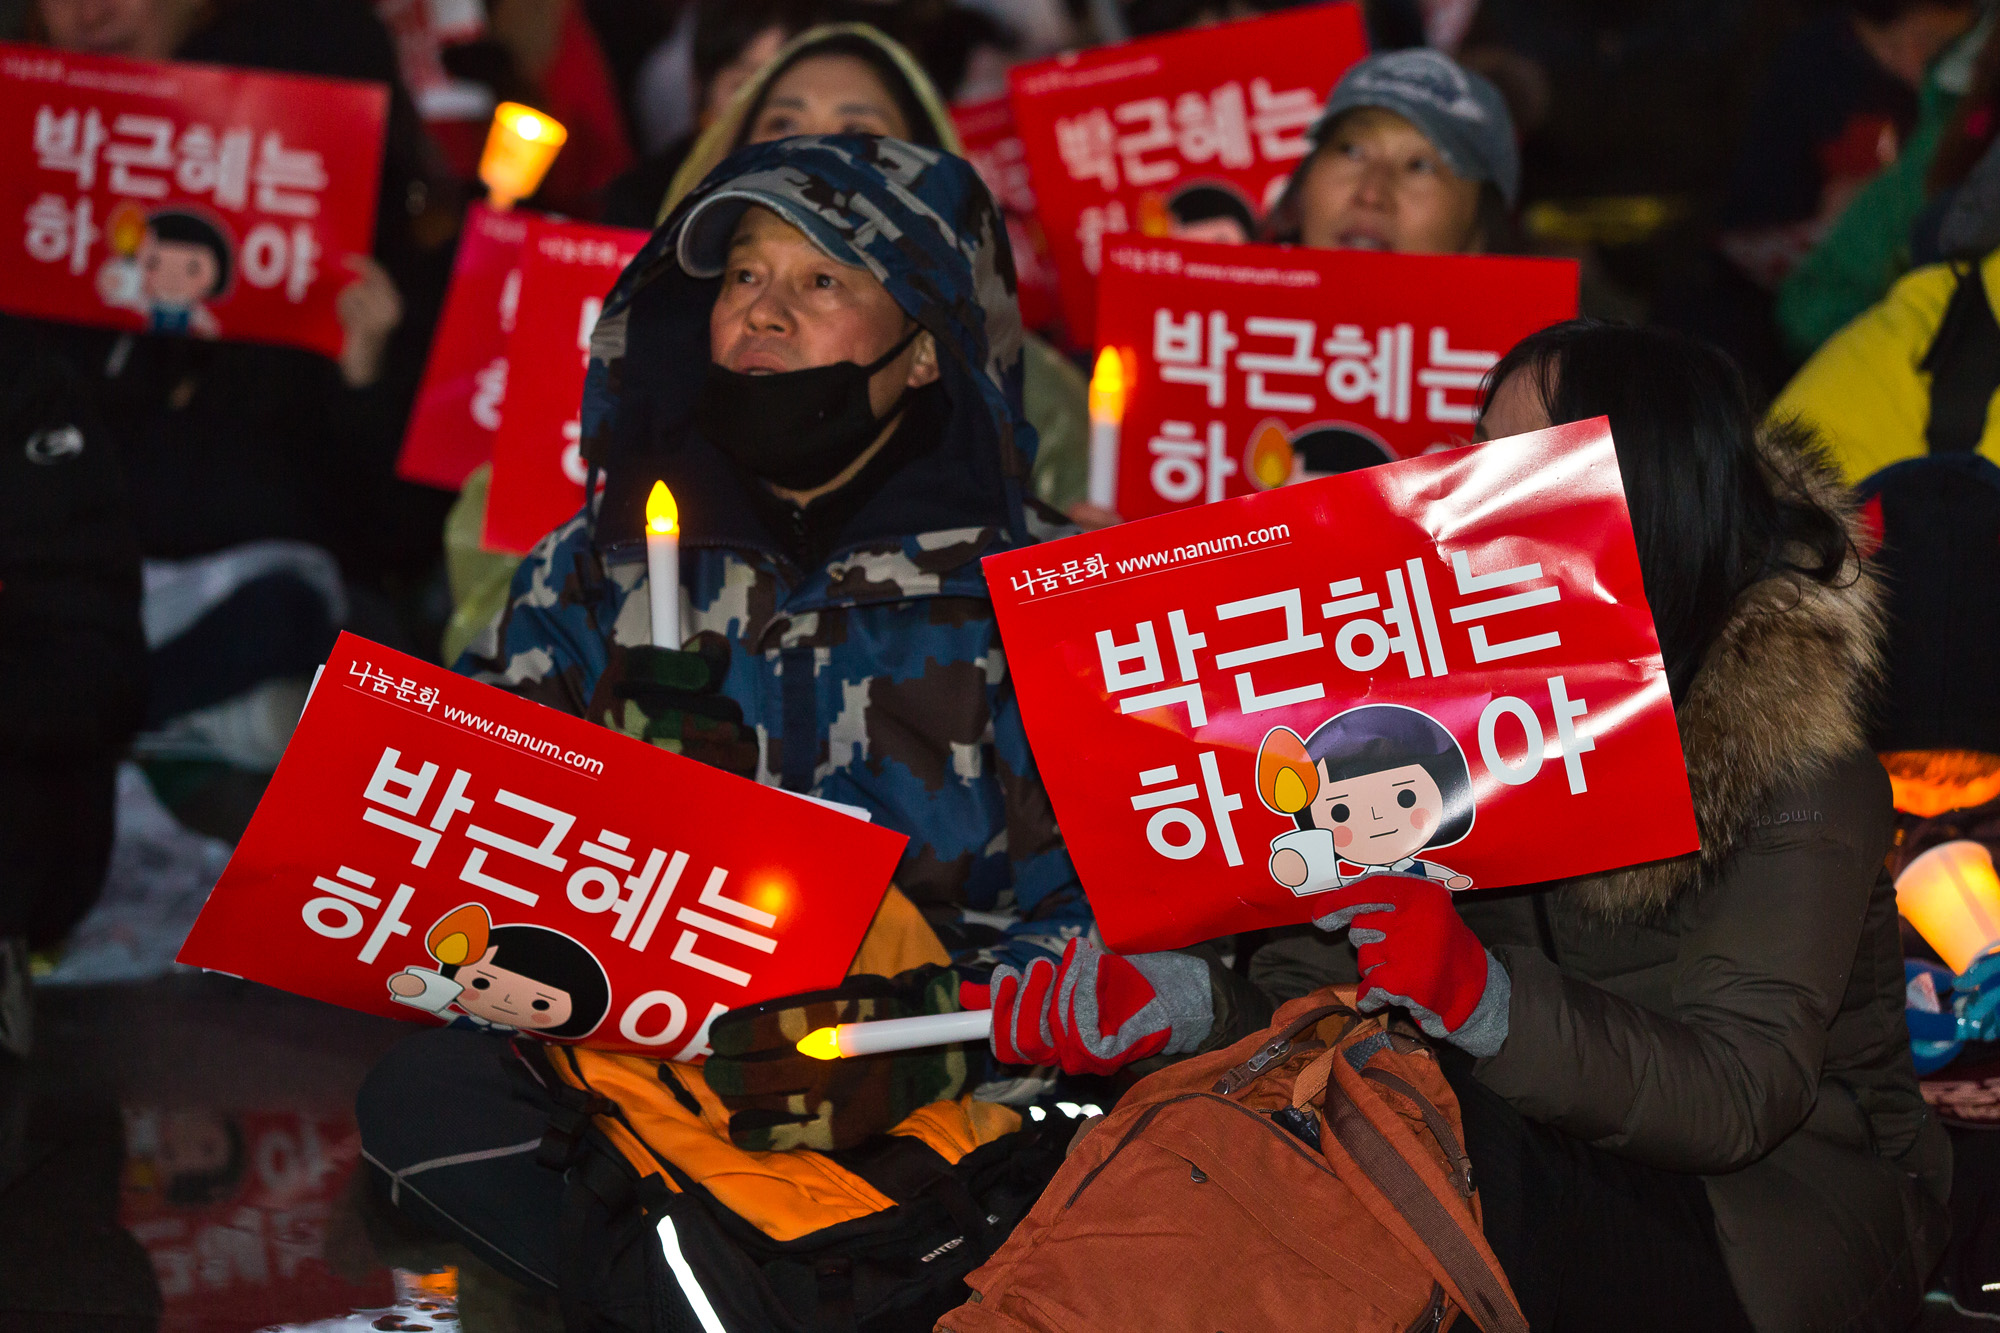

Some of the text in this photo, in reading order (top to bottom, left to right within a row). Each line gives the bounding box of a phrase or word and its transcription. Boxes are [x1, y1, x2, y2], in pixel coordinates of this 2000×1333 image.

[34, 105, 328, 217] 박근혜는
[25, 194, 320, 301] 하 야
[1152, 308, 1500, 425] 박근혜는
[1148, 420, 1237, 504] 하
[1010, 523, 1291, 596] 나눔문화 www.nanum.com
[1095, 550, 1562, 729] 박근혜는
[349, 660, 605, 776] 나눔문화 www.nanum.com
[1130, 675, 1595, 868] 하 야
[301, 866, 416, 965] 하
[362, 746, 779, 988] 박근혜는
